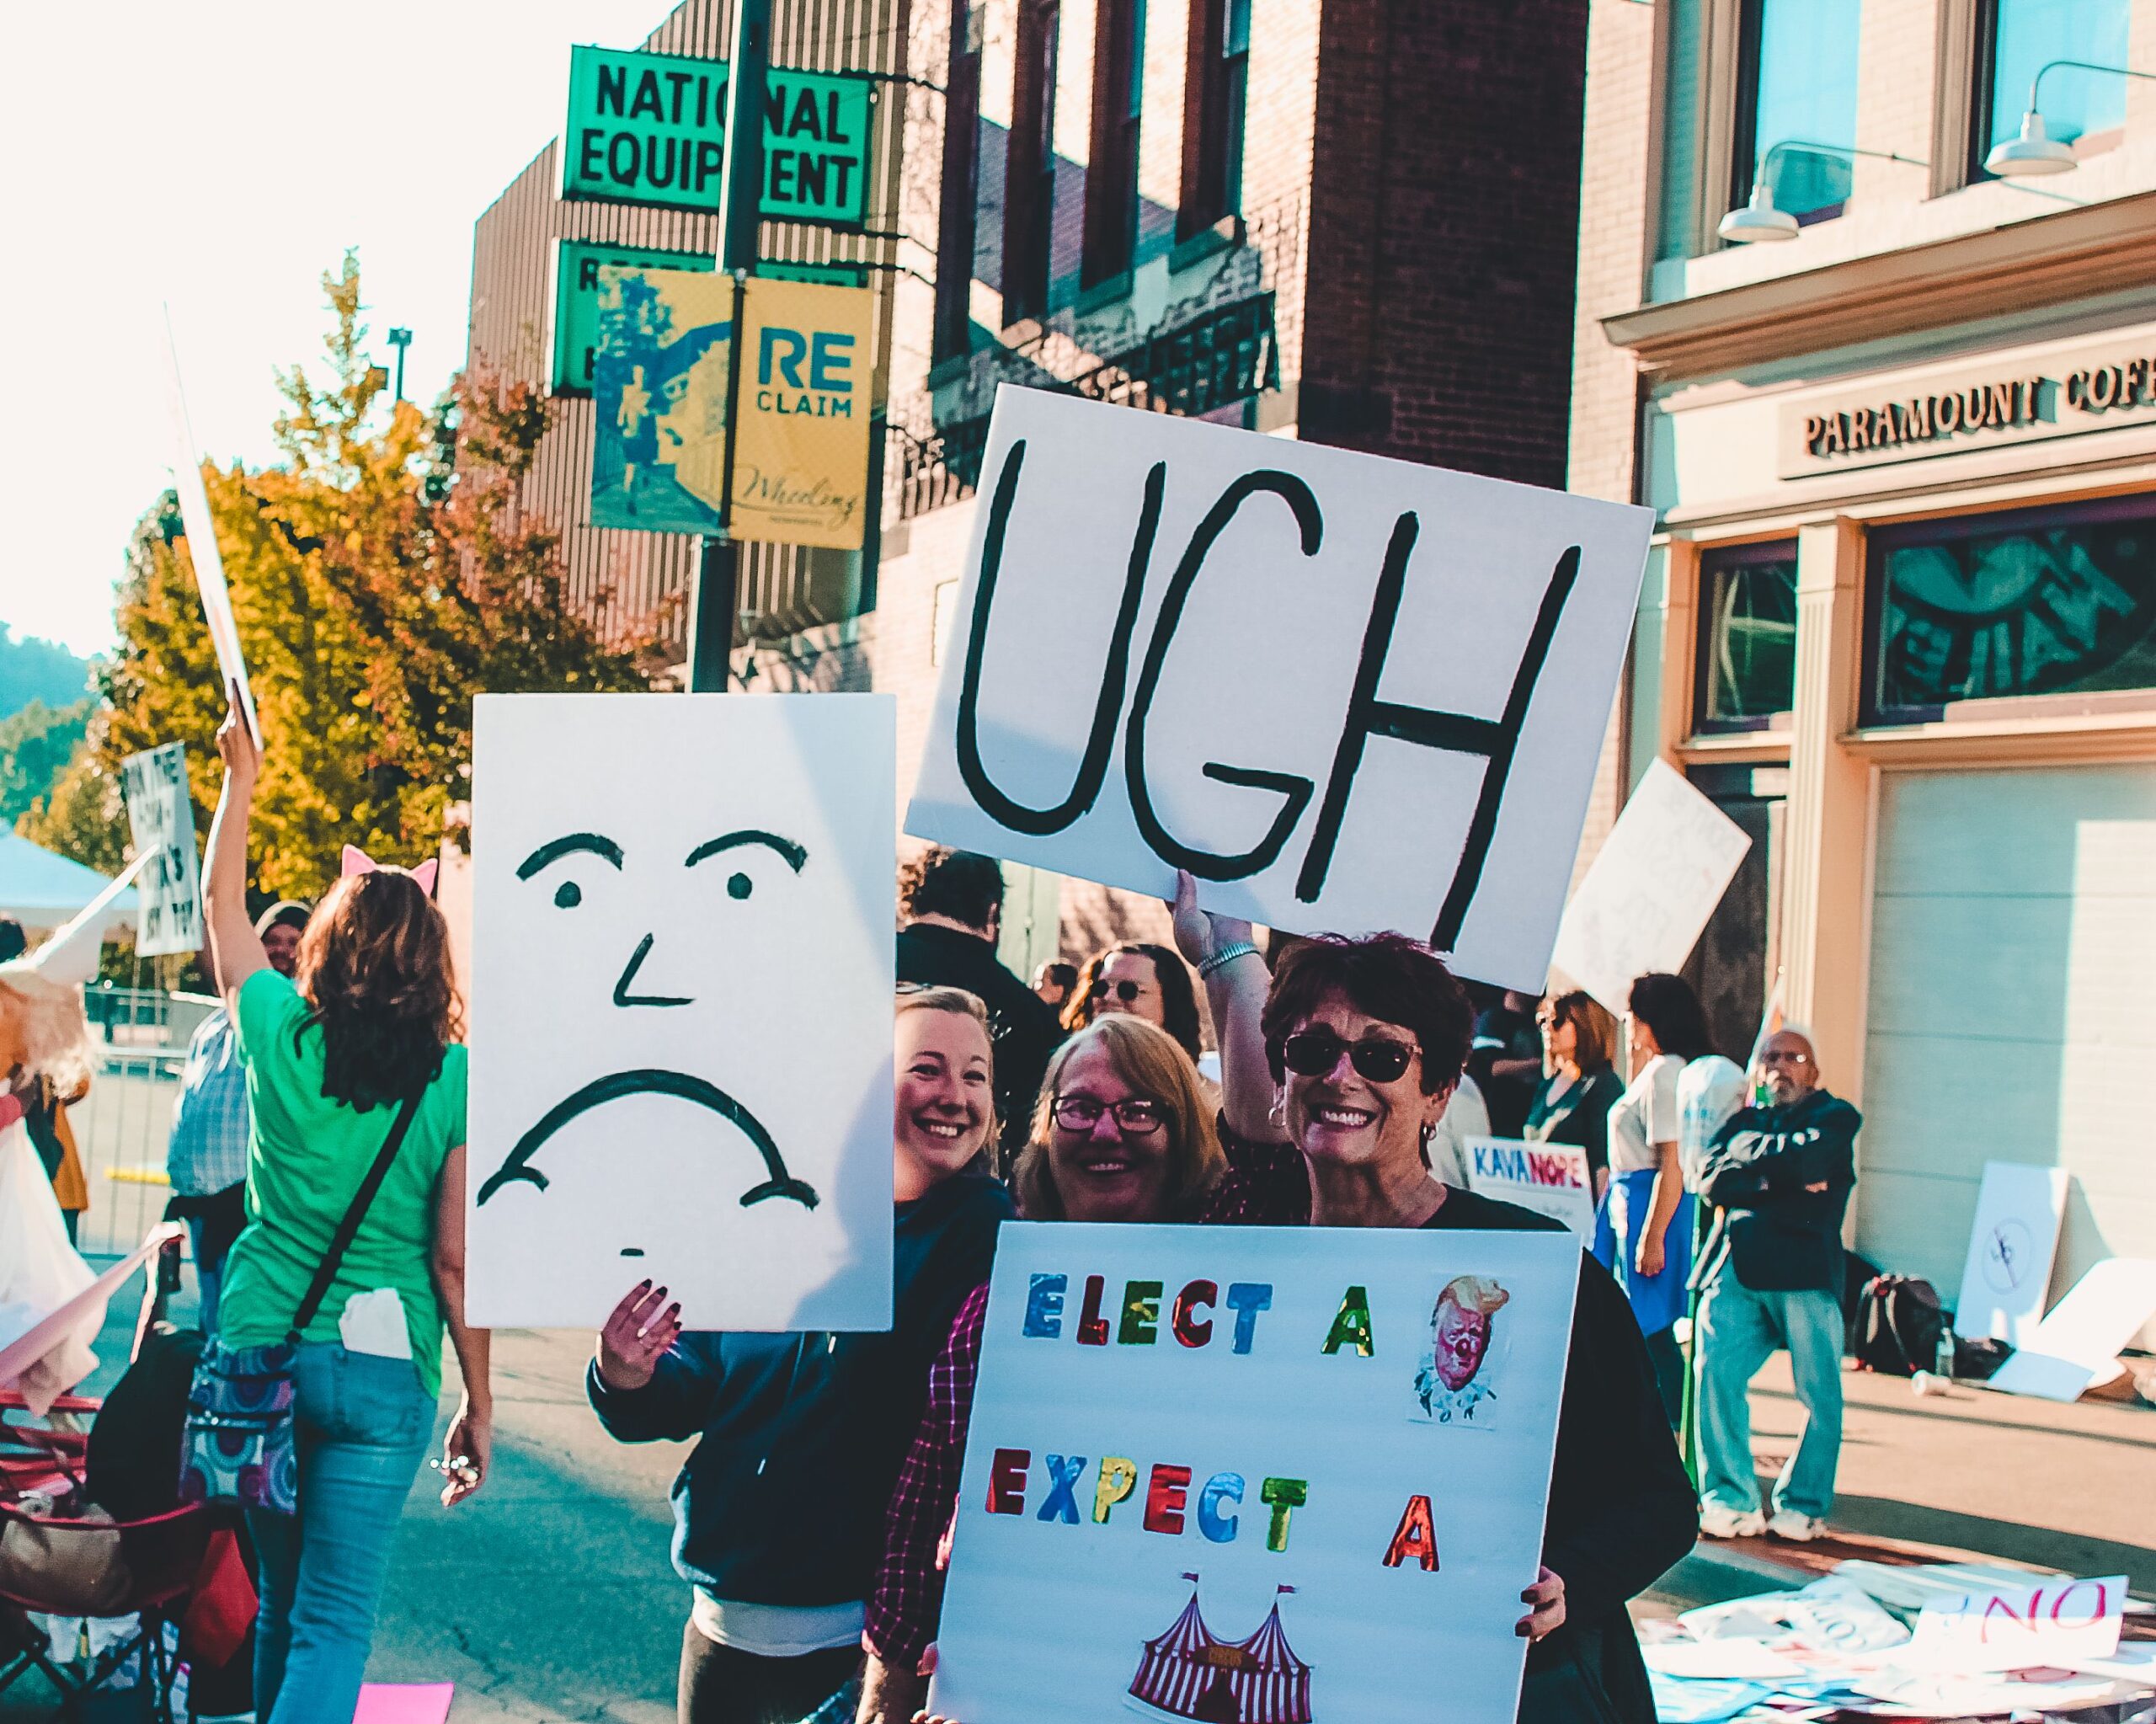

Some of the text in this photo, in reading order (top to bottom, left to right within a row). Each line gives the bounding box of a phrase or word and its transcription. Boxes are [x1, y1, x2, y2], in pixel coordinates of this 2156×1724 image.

[579, 127, 858, 208] EQUIPENT
[758, 326, 856, 392] RE
[757, 390, 851, 418] CLAIM
[1803, 376, 2040, 457] PARAMOUNT
[956, 439, 1582, 953] UGH
[1022, 1273, 1375, 1358] ELECT A
[985, 1447, 1440, 1572] EXPECT A
[1981, 1582, 2106, 1644] NO
